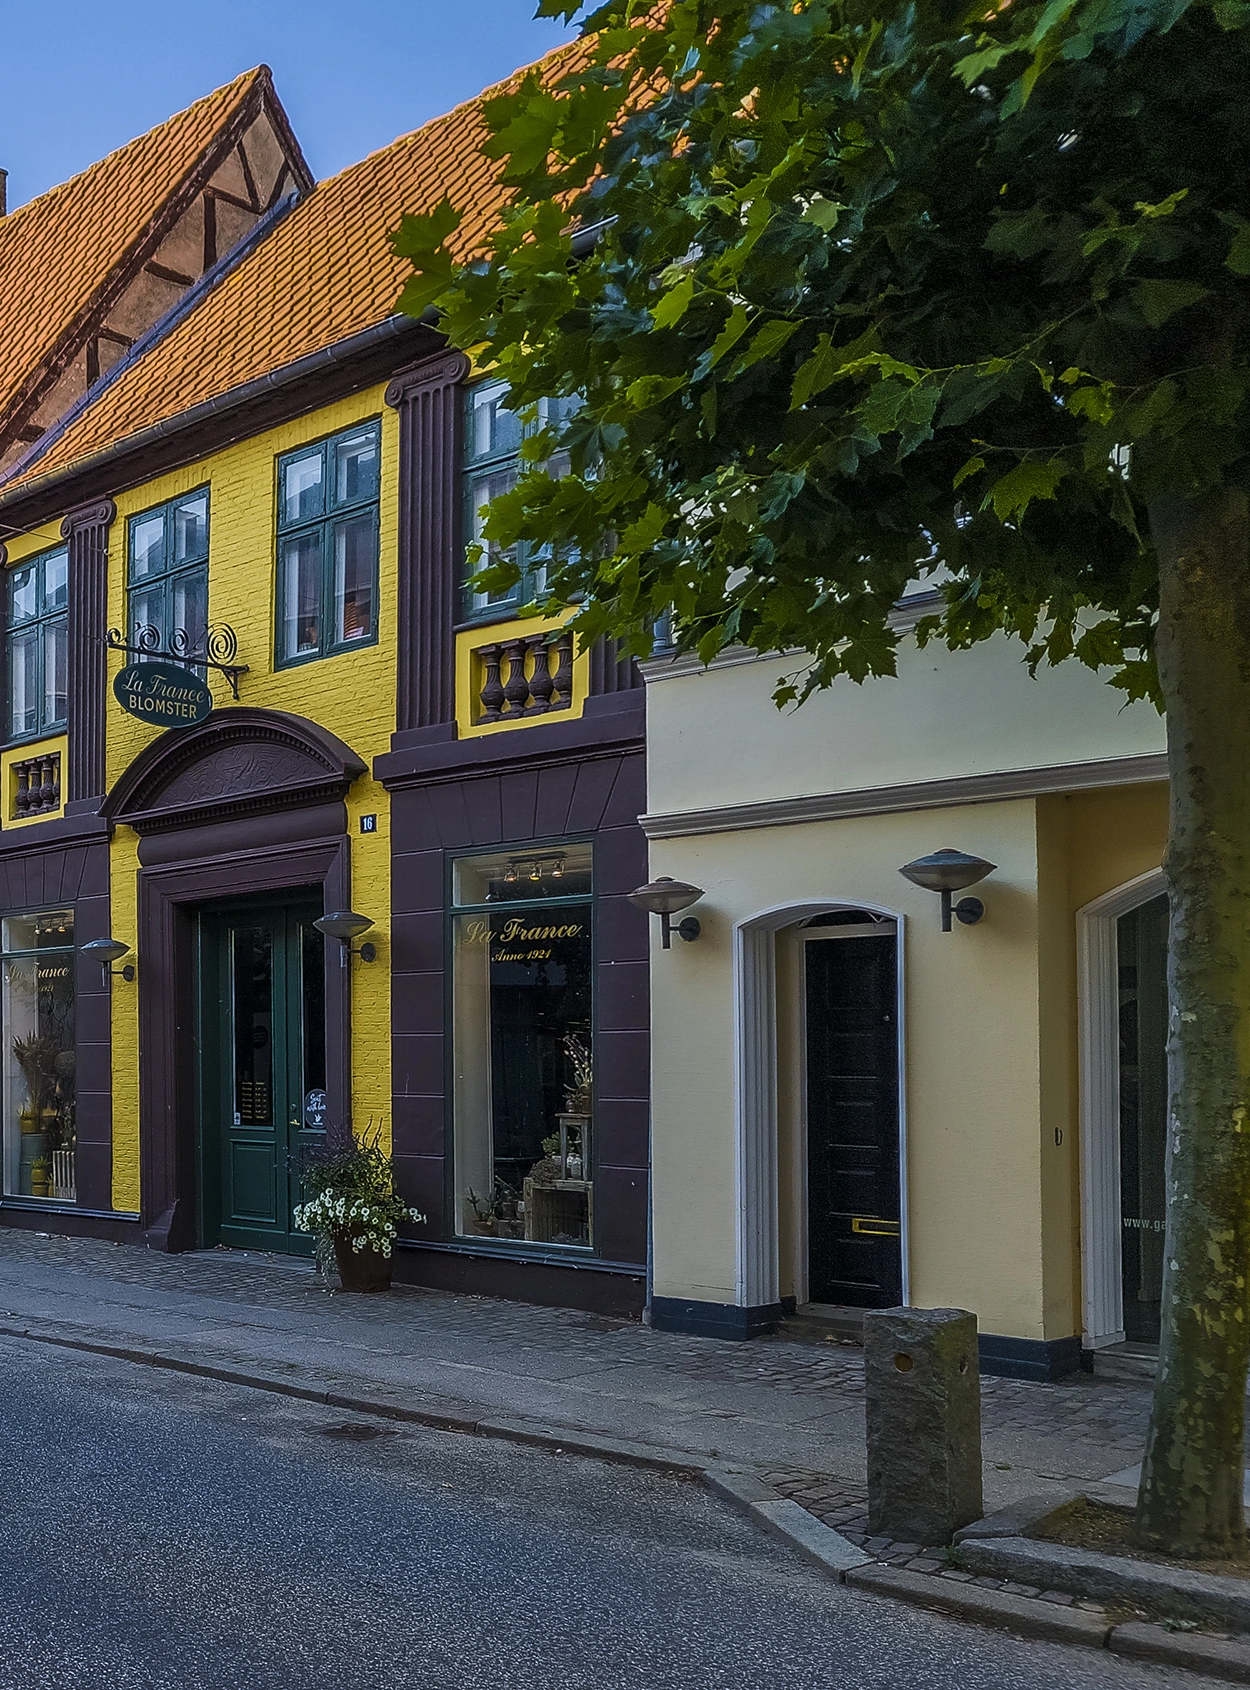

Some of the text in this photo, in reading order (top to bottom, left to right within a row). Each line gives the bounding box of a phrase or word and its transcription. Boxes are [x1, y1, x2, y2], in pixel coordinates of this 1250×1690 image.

[121, 669, 205, 703] La France
[129, 694, 197, 719] BLOMSTER
[363, 816, 373, 831] 16
[462, 918, 583, 945] La France
[491, 948, 552, 962] Anno 1921
